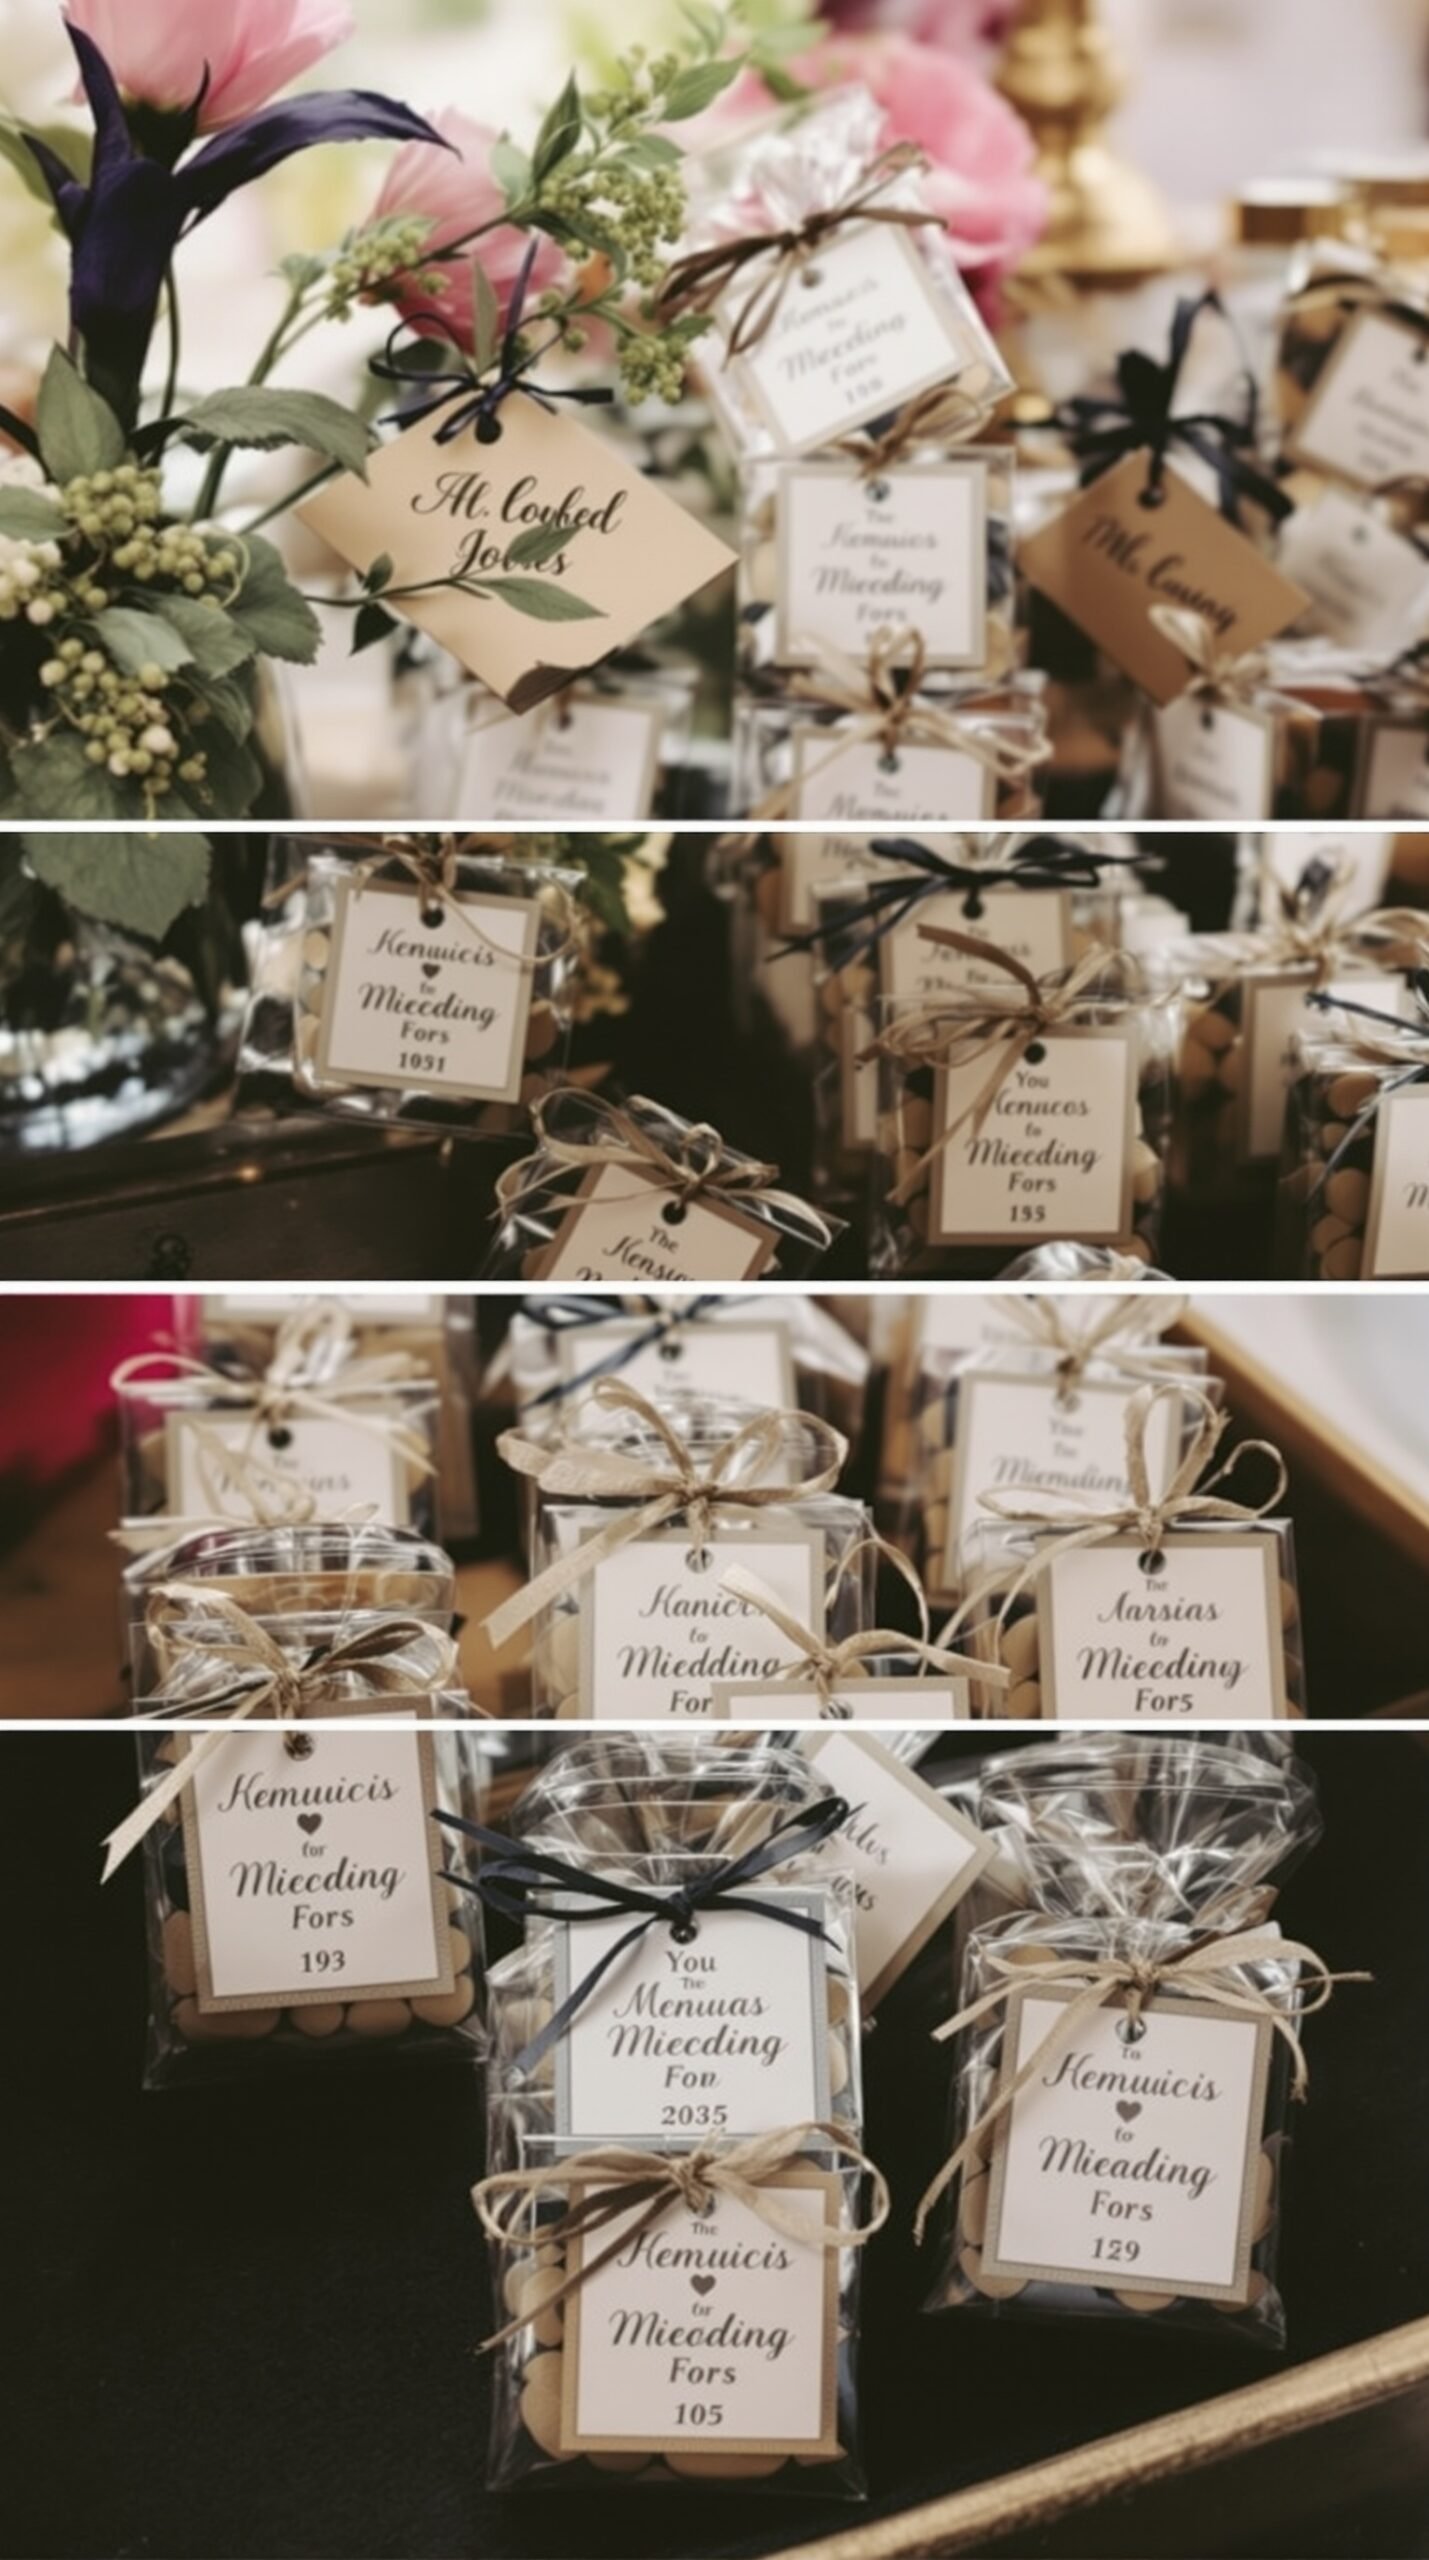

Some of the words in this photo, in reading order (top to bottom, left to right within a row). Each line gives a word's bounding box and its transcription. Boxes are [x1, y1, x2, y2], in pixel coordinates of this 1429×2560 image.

[400, 1020, 451, 1045] Fors
[1008, 1172, 1057, 1194] Fors
[292, 1905, 355, 1930] Fors
[301, 1950, 346, 1973] 193
[665, 1951, 717, 1973] You
[660, 2104, 729, 2126] 2035
[1090, 2189, 1154, 2221] Fors
[1091, 2236, 1141, 2262] 129
[669, 2357, 738, 2384] Fors
[675, 2403, 724, 2426] 105
